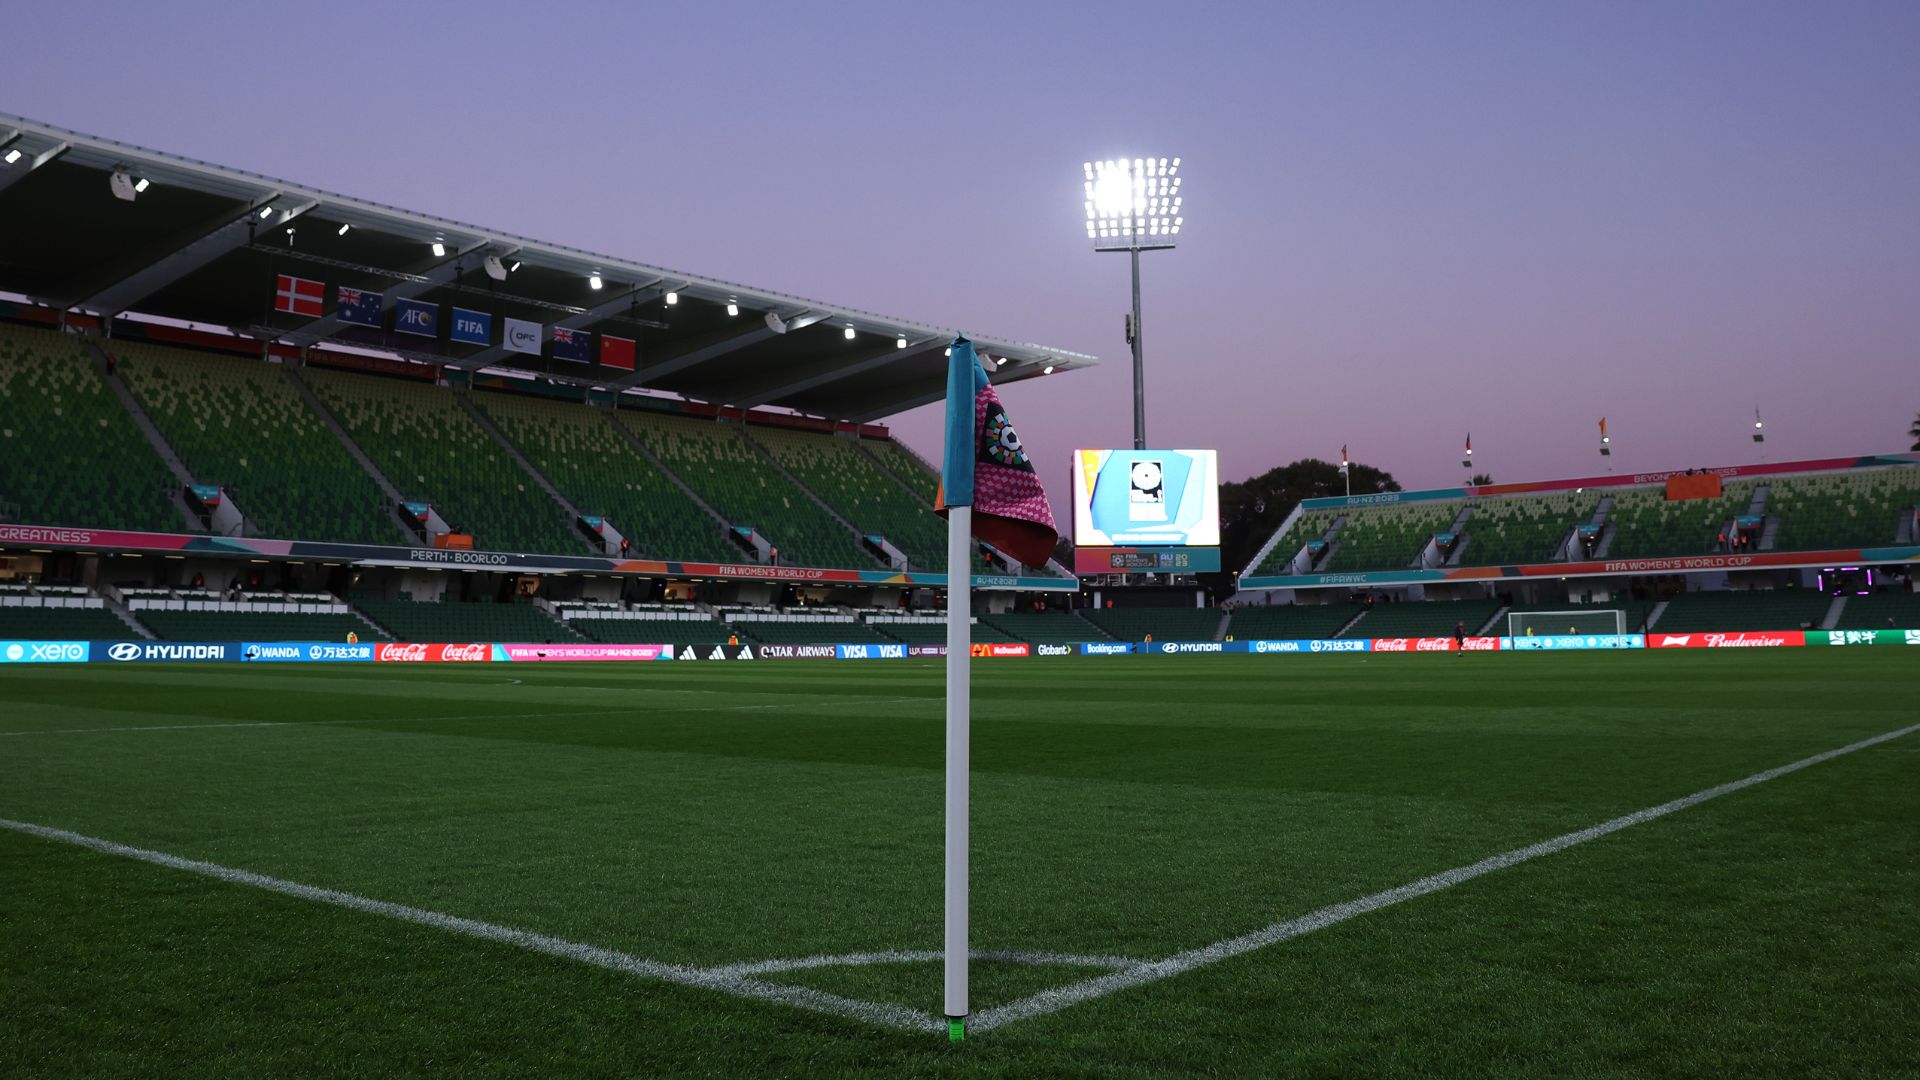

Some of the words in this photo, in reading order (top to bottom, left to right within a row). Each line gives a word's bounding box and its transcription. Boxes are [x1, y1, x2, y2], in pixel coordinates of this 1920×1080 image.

[400, 308, 430, 327] AFC
[457, 319, 484, 335] FIFA
[515, 331, 535, 342] OFC
[0, 527, 91, 543] GREATNESS
[411, 550, 448, 562] PERTH
[454, 553, 508, 565] BOORLOO
[1605, 562, 1628, 572] FIFA
[1629, 559, 1682, 570] WOMEN'S
[1684, 557, 1725, 568] WORLD
[1727, 556, 1751, 566] CUP
[719, 566, 736, 575] FIFA
[737, 567, 776, 577] WOMEN'S
[777, 569, 805, 578] WORLD
[806, 570, 823, 579] CUP
[1268, 642, 1299, 651] WANDA
[1556, 638, 1584, 647] xero
[1704, 633, 1785, 648] Budweiser
[31, 643, 84, 660] xero
[146, 646, 224, 659] HYUNDAI
[261, 647, 300, 658] WANDA
[511, 649, 528, 657] FIFA
[565, 649, 591, 657] WORLD
[591, 649, 607, 657] CUP
[761, 646, 793, 658] QATAR
[796, 646, 835, 657] AIRWAYS
[842, 645, 867, 658] VISA
[878, 645, 903, 658] VISA
[1038, 645, 1067, 655] Globant
[1088, 644, 1127, 655] Booking.com
[1180, 644, 1222, 652] HYUNDAI
